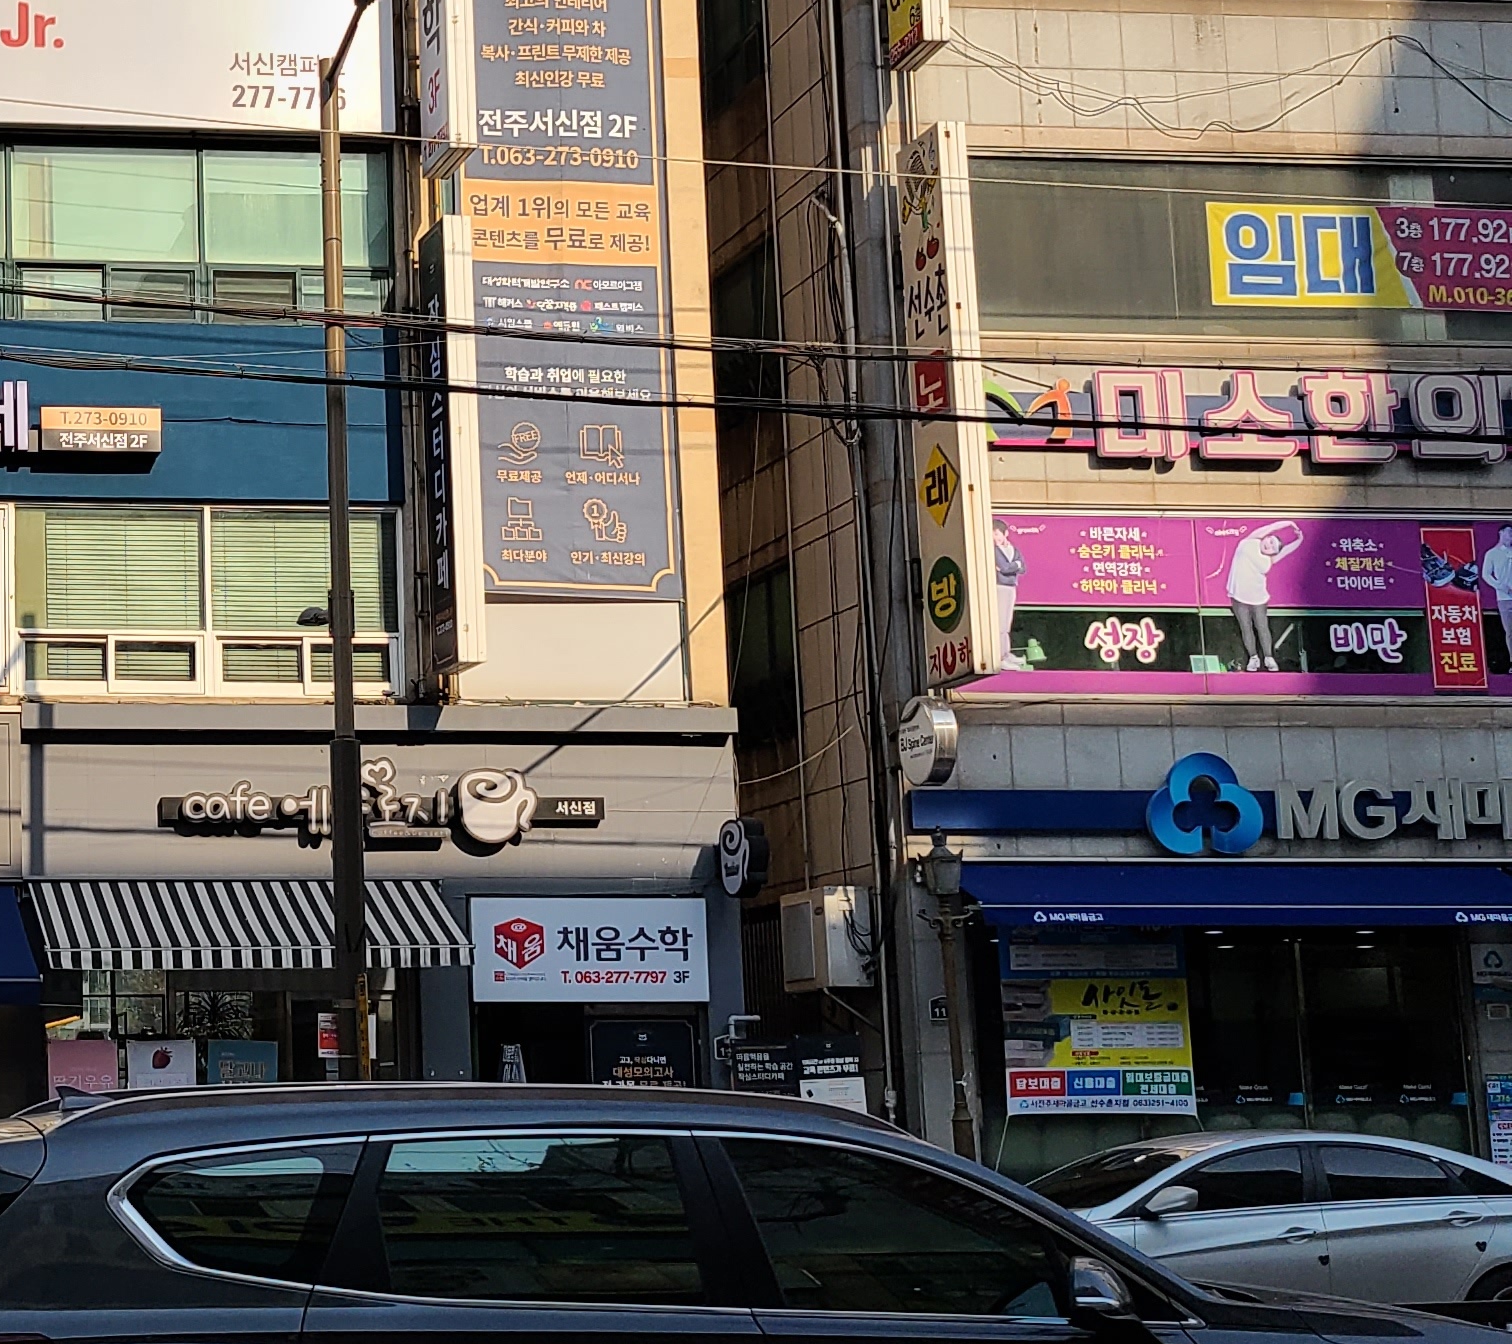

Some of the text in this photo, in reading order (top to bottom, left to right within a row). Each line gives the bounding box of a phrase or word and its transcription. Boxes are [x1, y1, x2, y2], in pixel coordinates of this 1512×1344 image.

[0, 1, 64, 49] Jr.
[592, 20, 606, 37] 차
[562, 45, 603, 63] 무제한
[605, 47, 632, 66] 제공
[514, 70, 606, 88] 최신인강 무료
[428, 68, 441, 114] 3F
[478, 109, 637, 138] 전주서신점 2F
[481, 143, 639, 169] T.063-273-0910
[469, 193, 651, 222] 업계 1위의 모든 교육
[1396, 216, 1512, 244] 3층 177.92
[472, 227, 650, 253] 콘텐츠를 무료로 제공!
[1225, 211, 1376, 297] 임대
[1399, 251, 1425, 273] 7층
[504, 366, 626, 384] 학습과 취업에 필요한
[60, 410, 148, 427] T.273-0910
[59, 431, 148, 449] 전주서신점 2F
[514, 432, 539, 444] FREE
[496, 469, 542, 484] 무료제공
[1088, 527, 1141, 542] 바른자세
[1077, 543, 1156, 560] 숨은키 클리닉
[1339, 538, 1379, 552] 위축소
[501, 549, 547, 563] 최다분야
[1334, 556, 1386, 572] 체질개선
[1092, 561, 1143, 577] 면역강화
[1080, 579, 1158, 595] 허약아 클리닉
[1336, 575, 1386, 591] 다이어트
[1431, 604, 1479, 623] 자동차
[1084, 616, 1408, 664] 성장 비만
[1441, 628, 1473, 646] 보험
[1440, 650, 1479, 674] 진료
[182, 780, 273, 823] cafe
[555, 799, 597, 818] 서신점
[495, 925, 694, 964] 채움 채움수학
[561, 970, 572, 984] T.
[574, 970, 668, 984] 063-277-7797
[673, 970, 691, 984] 3F
